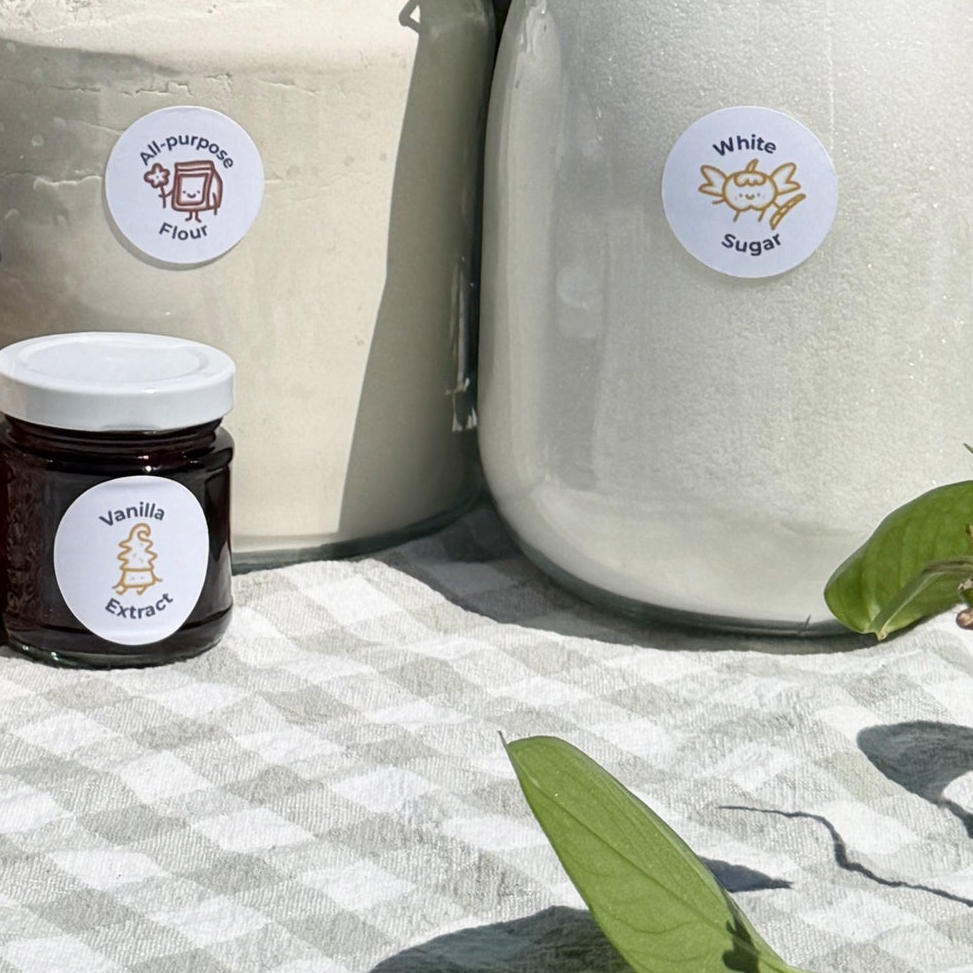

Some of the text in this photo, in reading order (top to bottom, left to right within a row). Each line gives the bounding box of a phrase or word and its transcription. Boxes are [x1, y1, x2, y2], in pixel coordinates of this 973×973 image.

[139, 134, 234, 169] All-purpose
[712, 133, 777, 157] White
[158, 222, 208, 241] Flour
[720, 233, 782, 257] Sugar
[98, 501, 165, 527] Vanilla
[104, 593, 173, 620] Extract
